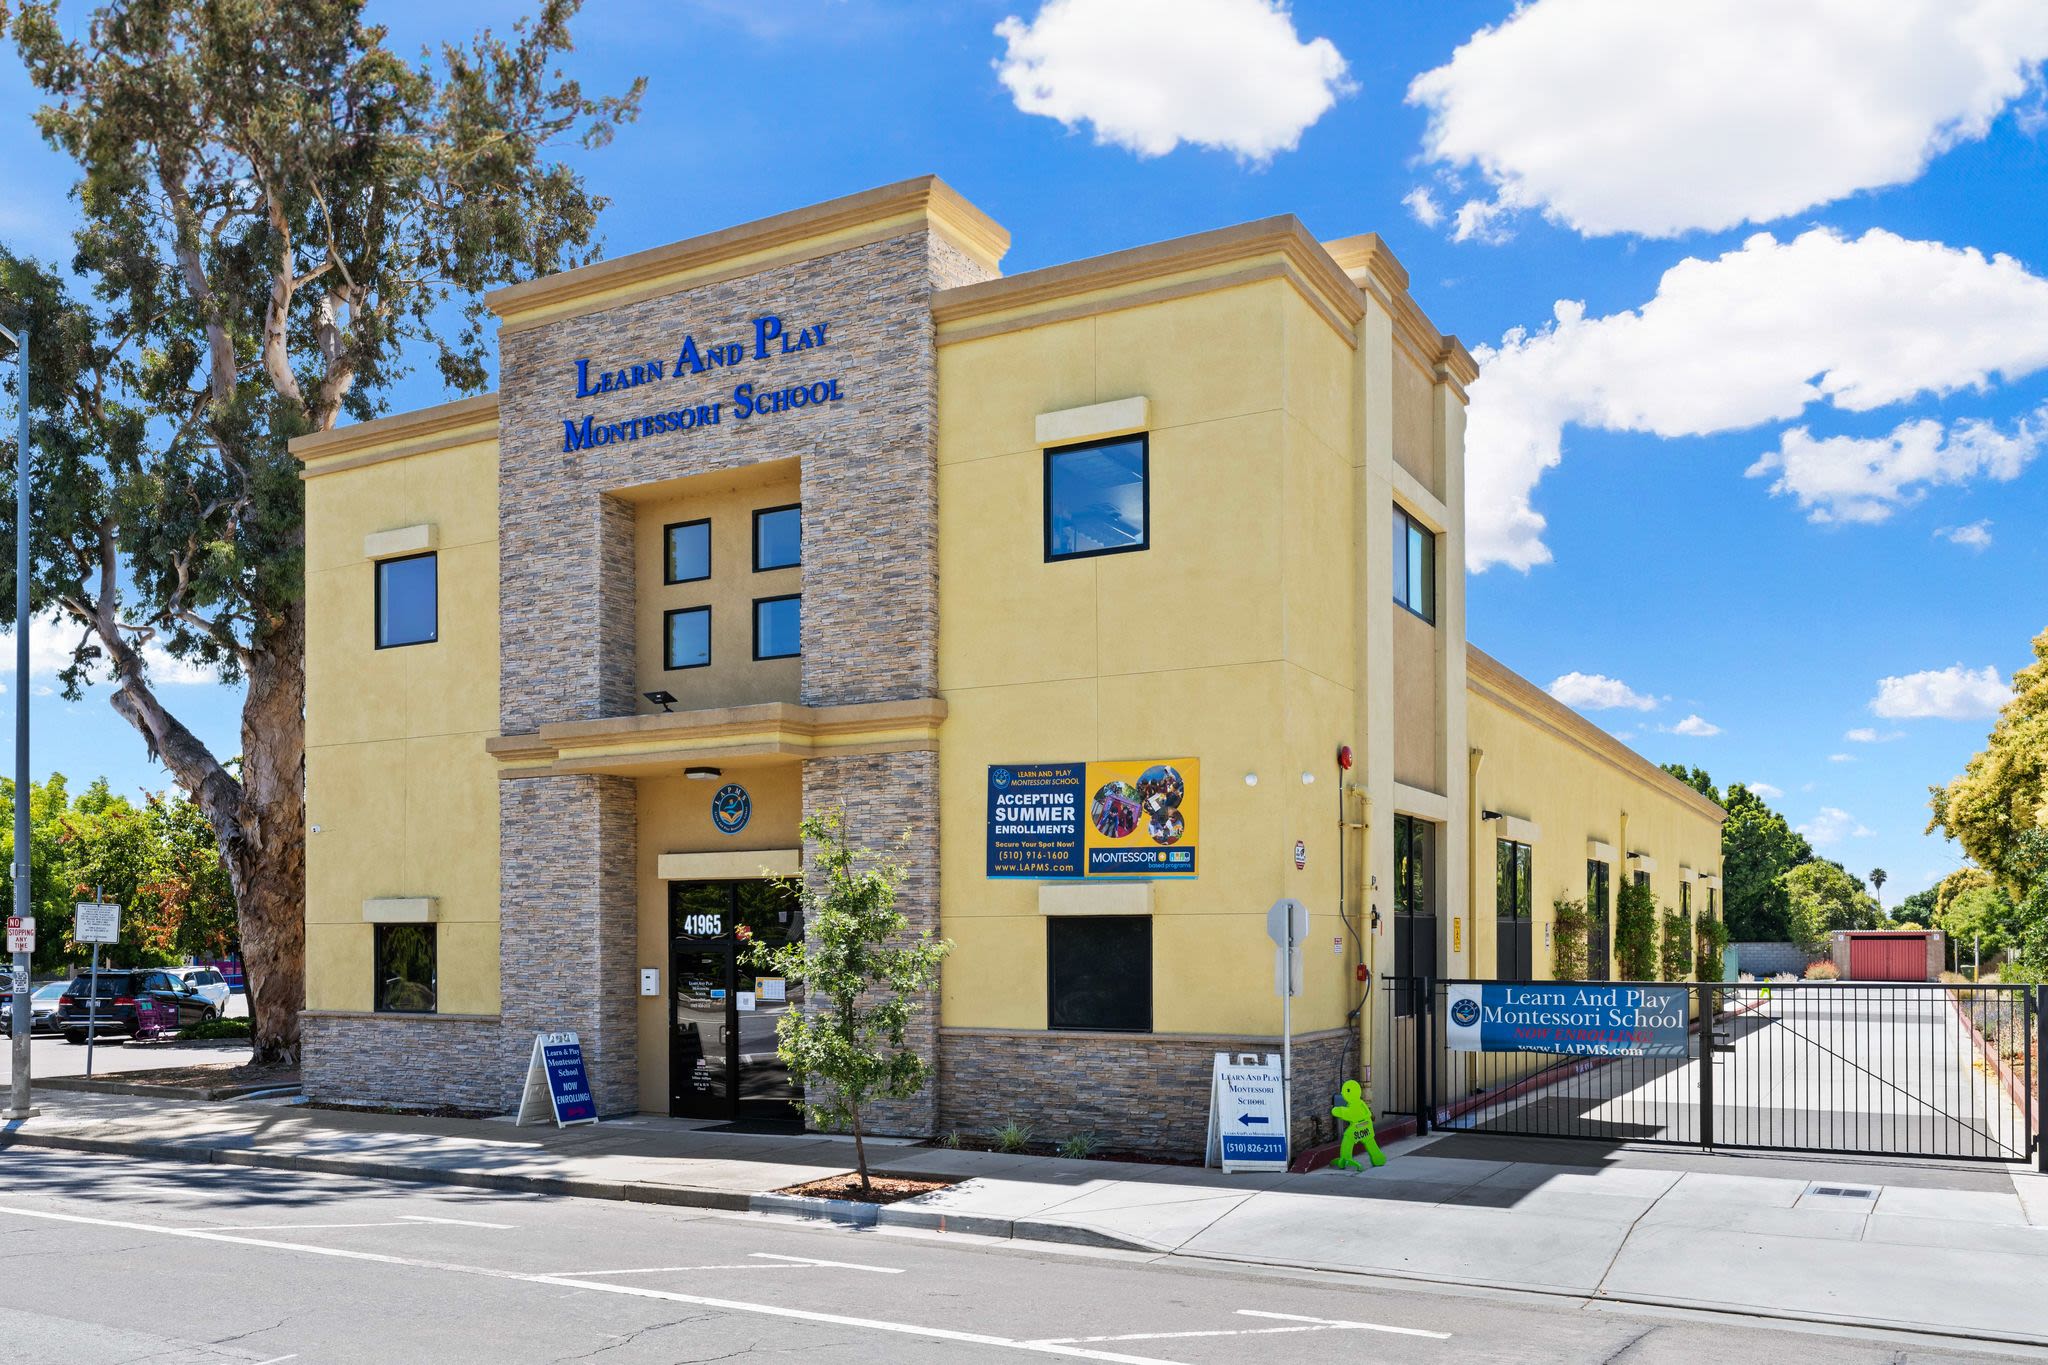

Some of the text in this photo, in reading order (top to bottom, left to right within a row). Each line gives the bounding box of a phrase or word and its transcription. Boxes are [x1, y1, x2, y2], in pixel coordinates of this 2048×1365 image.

[574, 316, 829, 400] LEARN AND PLAY
[563, 378, 844, 453] MONTESSORI SCHOOL
[1055, 769, 1072, 777] PLAY
[1052, 777, 1080, 786] SCHOOL
[996, 793, 1074, 806] ACCEPTING
[995, 807, 1076, 822] SUMMER
[995, 824, 1075, 834] ENROLLMENTS
[1038, 841, 1055, 850] Spot
[999, 851, 1069, 861] (510) 916-1600
[1092, 852, 1157, 864] MONTESSORI
[995, 863, 1074, 872] www.LAPMS.com
[9, 919, 20, 927] NO
[684, 914, 721, 935] 41965
[1505, 988, 1671, 1014] Learn And Play
[1484, 1006, 1600, 1027] Montessori
[1608, 1008, 1683, 1028] School
[1513, 1027, 1654, 1043] NOW ENROLLING!
[546, 1049, 562, 1057] Learn
[569, 1048, 580, 1056] Play
[1518, 1043, 1643, 1057] www.LAPMS.com
[548, 1057, 582, 1067] Montessori
[558, 1068, 579, 1077] School
[1221, 1073, 1245, 1081] LEARN
[1262, 1074, 1280, 1082] PLAY
[563, 1081, 578, 1091] NOW
[1230, 1085, 1274, 1094] MONTESSORI
[556, 1092, 590, 1105] ENROLLING!
[1238, 1097, 1266, 1105] SCHOOL
[1227, 1143, 1282, 1154] (510) 826-2111
